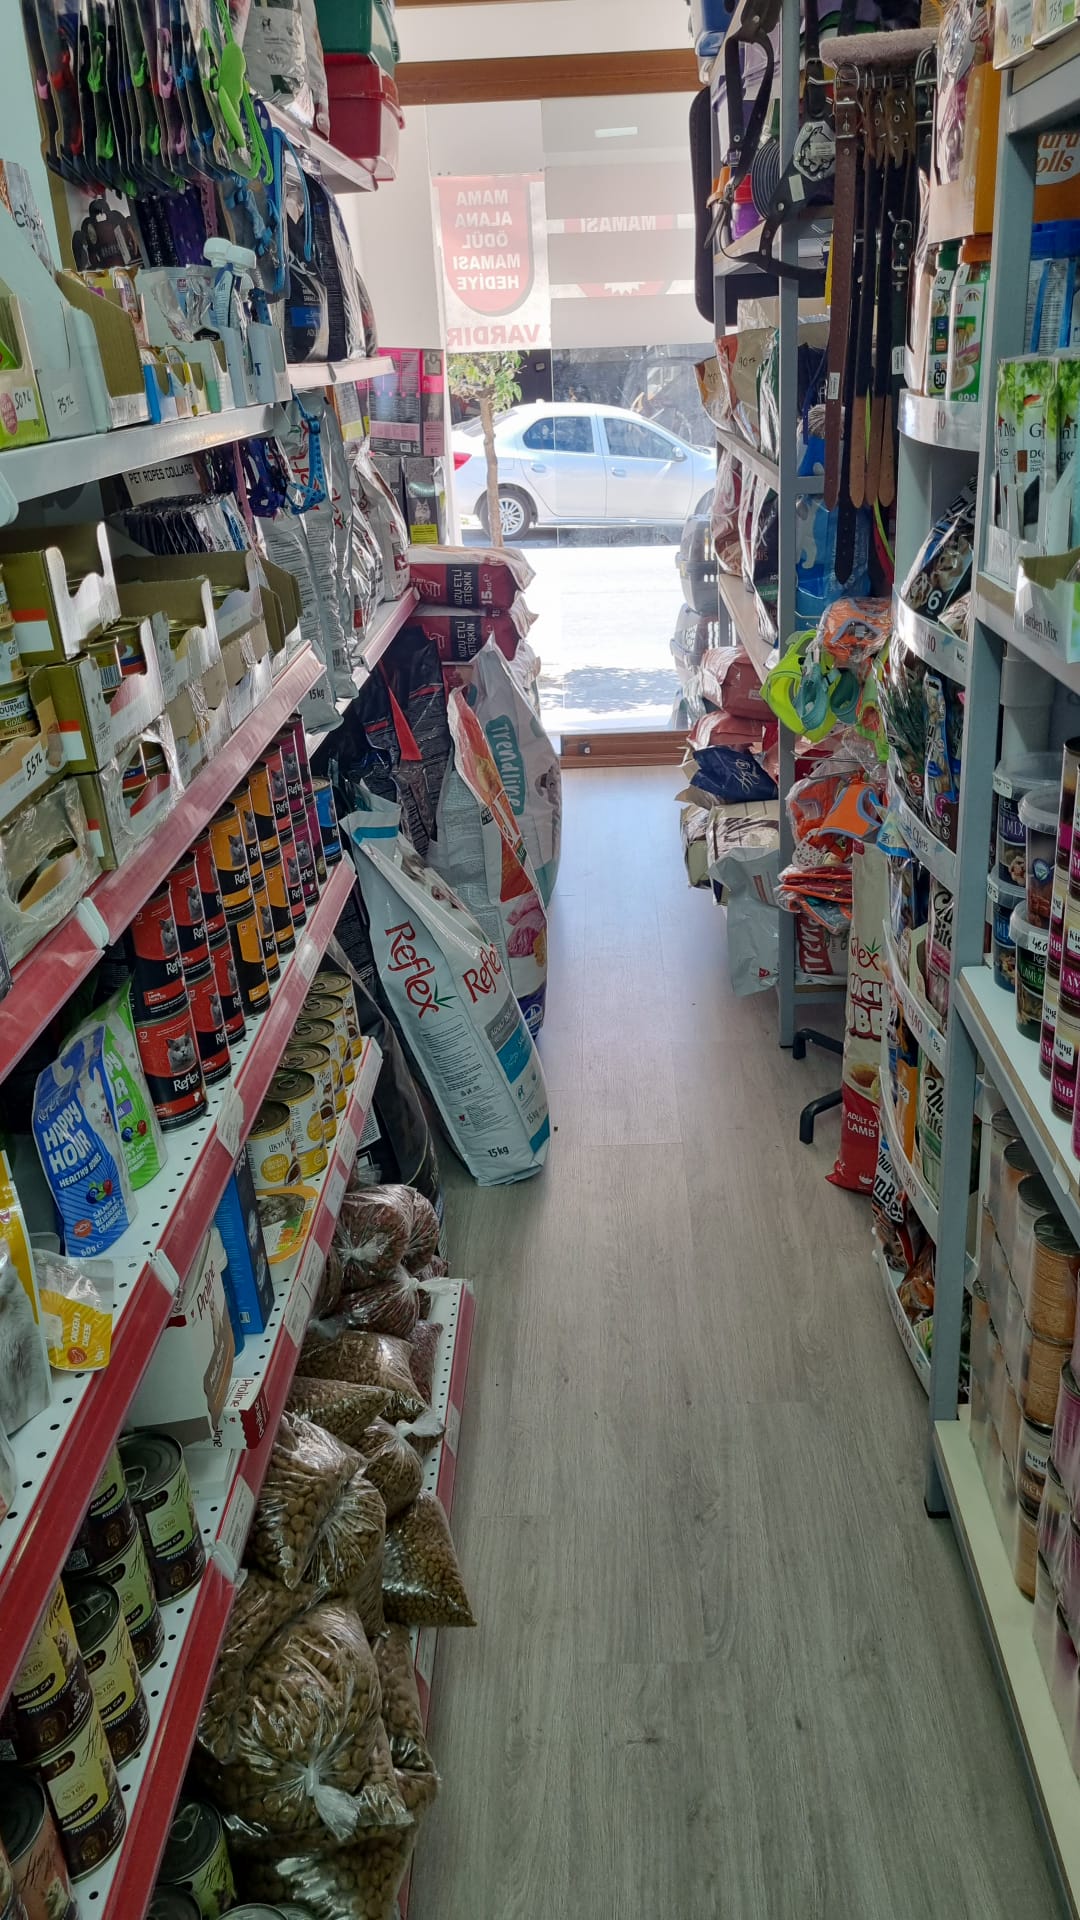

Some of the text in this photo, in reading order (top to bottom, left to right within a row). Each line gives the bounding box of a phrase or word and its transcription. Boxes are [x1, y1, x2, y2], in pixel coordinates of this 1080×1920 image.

[1036, 150, 1074, 172] olls
[128, 463, 194, 485] PET ROPES COLLARS
[927, 589, 943, 610] 6
[1024, 613, 1043, 634] arden
[0, 700, 27, 716] OURMET
[490, 723, 521, 808] Trendline
[287, 783, 302, 796] Refle
[934, 924, 953, 948] Bite
[384, 919, 440, 1019] Reflex
[462, 943, 503, 1004] Refle
[1044, 1002, 1057, 1020] ing
[173, 1070, 200, 1094] Reflex
[42, 1100, 83, 1151] HAPPY
[847, 1111, 879, 1129] ADULT CA
[847, 1119, 876, 1138] LAMB
[48, 1130, 93, 1175] HOUR
[487, 1145, 510, 1159] 15kg
[58, 1162, 90, 1188] HEALTHY
[232, 1378, 255, 1409] Proline
[213, 1426, 224, 1449] line
